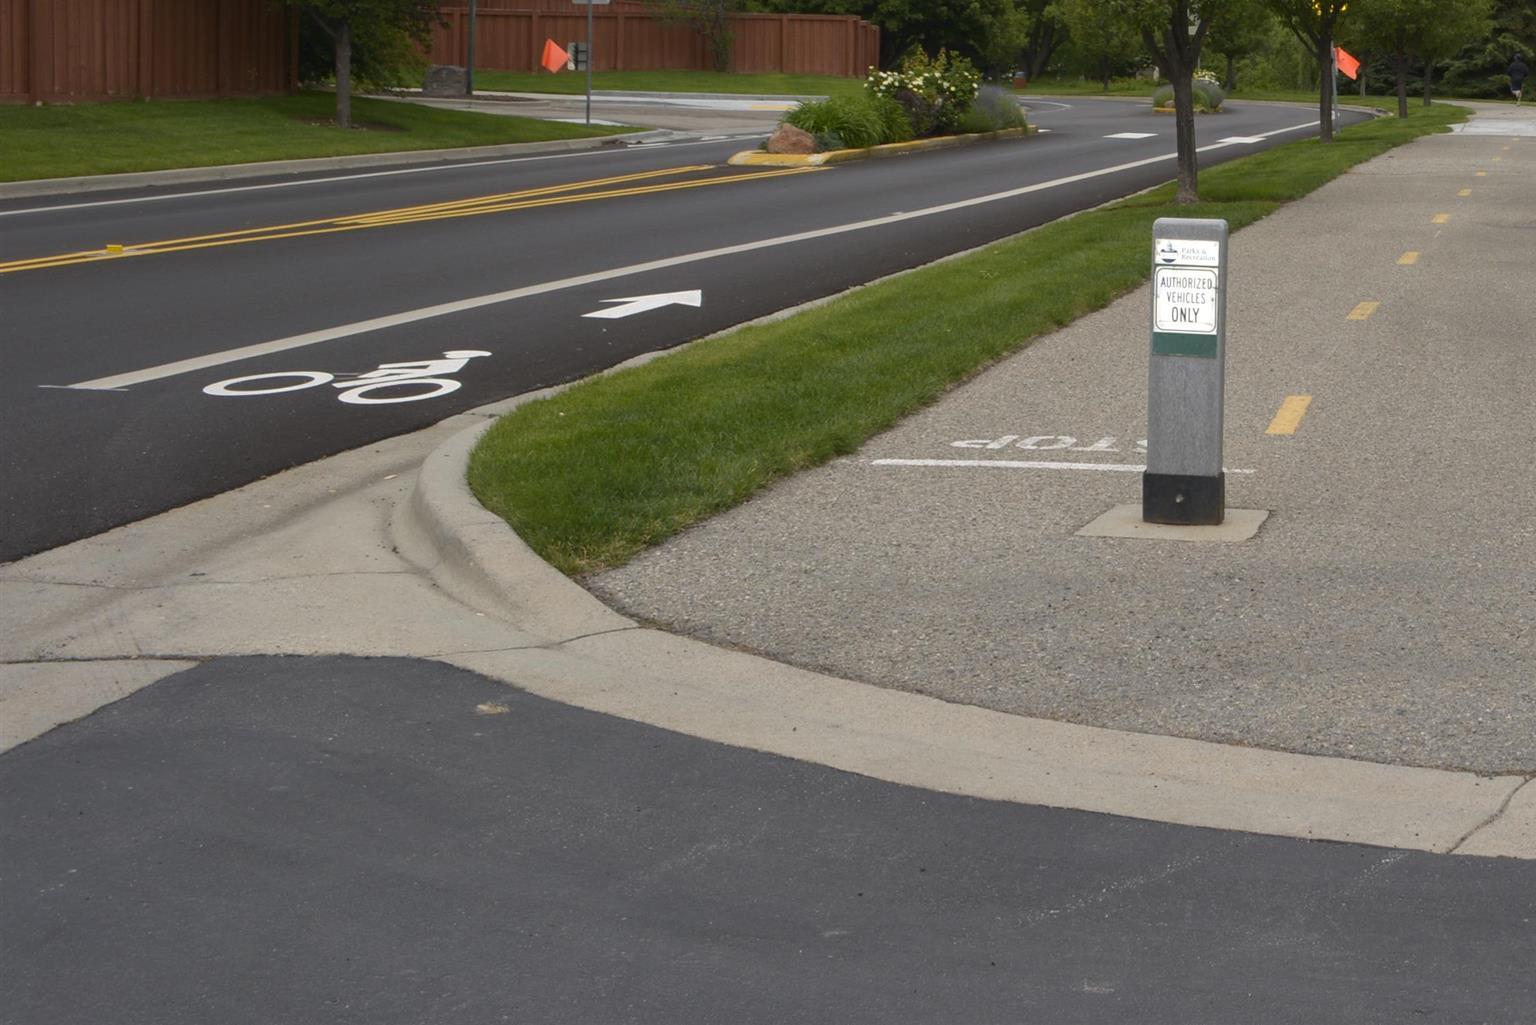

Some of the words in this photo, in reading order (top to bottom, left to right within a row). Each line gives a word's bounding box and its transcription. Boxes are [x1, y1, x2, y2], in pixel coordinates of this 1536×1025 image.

[1181, 254, 1216, 262] Recreation
[1160, 276, 1213, 290] AUTHORIZED
[1166, 291, 1206, 304] VEHICLES
[1171, 306, 1200, 323] ONLY
[950, 435, 1147, 453] TOP
